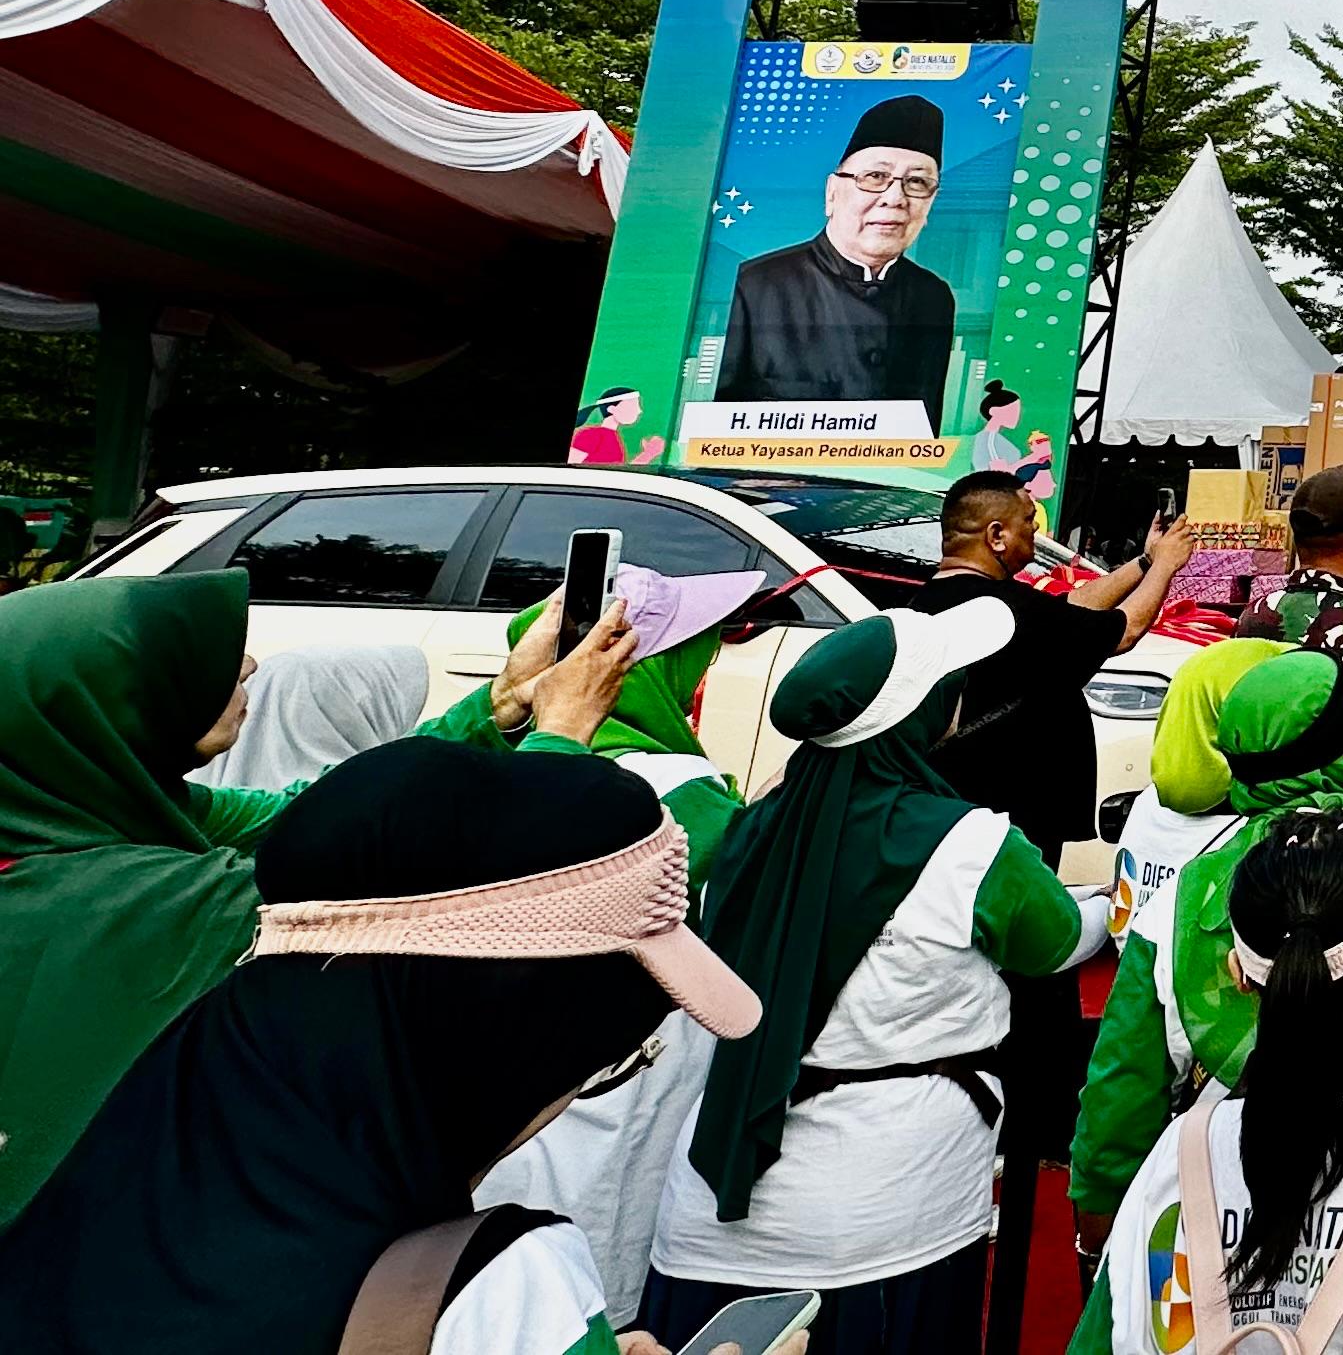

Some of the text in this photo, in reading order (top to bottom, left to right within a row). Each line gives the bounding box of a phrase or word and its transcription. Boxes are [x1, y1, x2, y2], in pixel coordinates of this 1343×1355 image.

[730, 412, 877, 431] H. Hildi Hamid
[701, 443, 946, 460] Ketua Yayasan Pendidikan OSO
